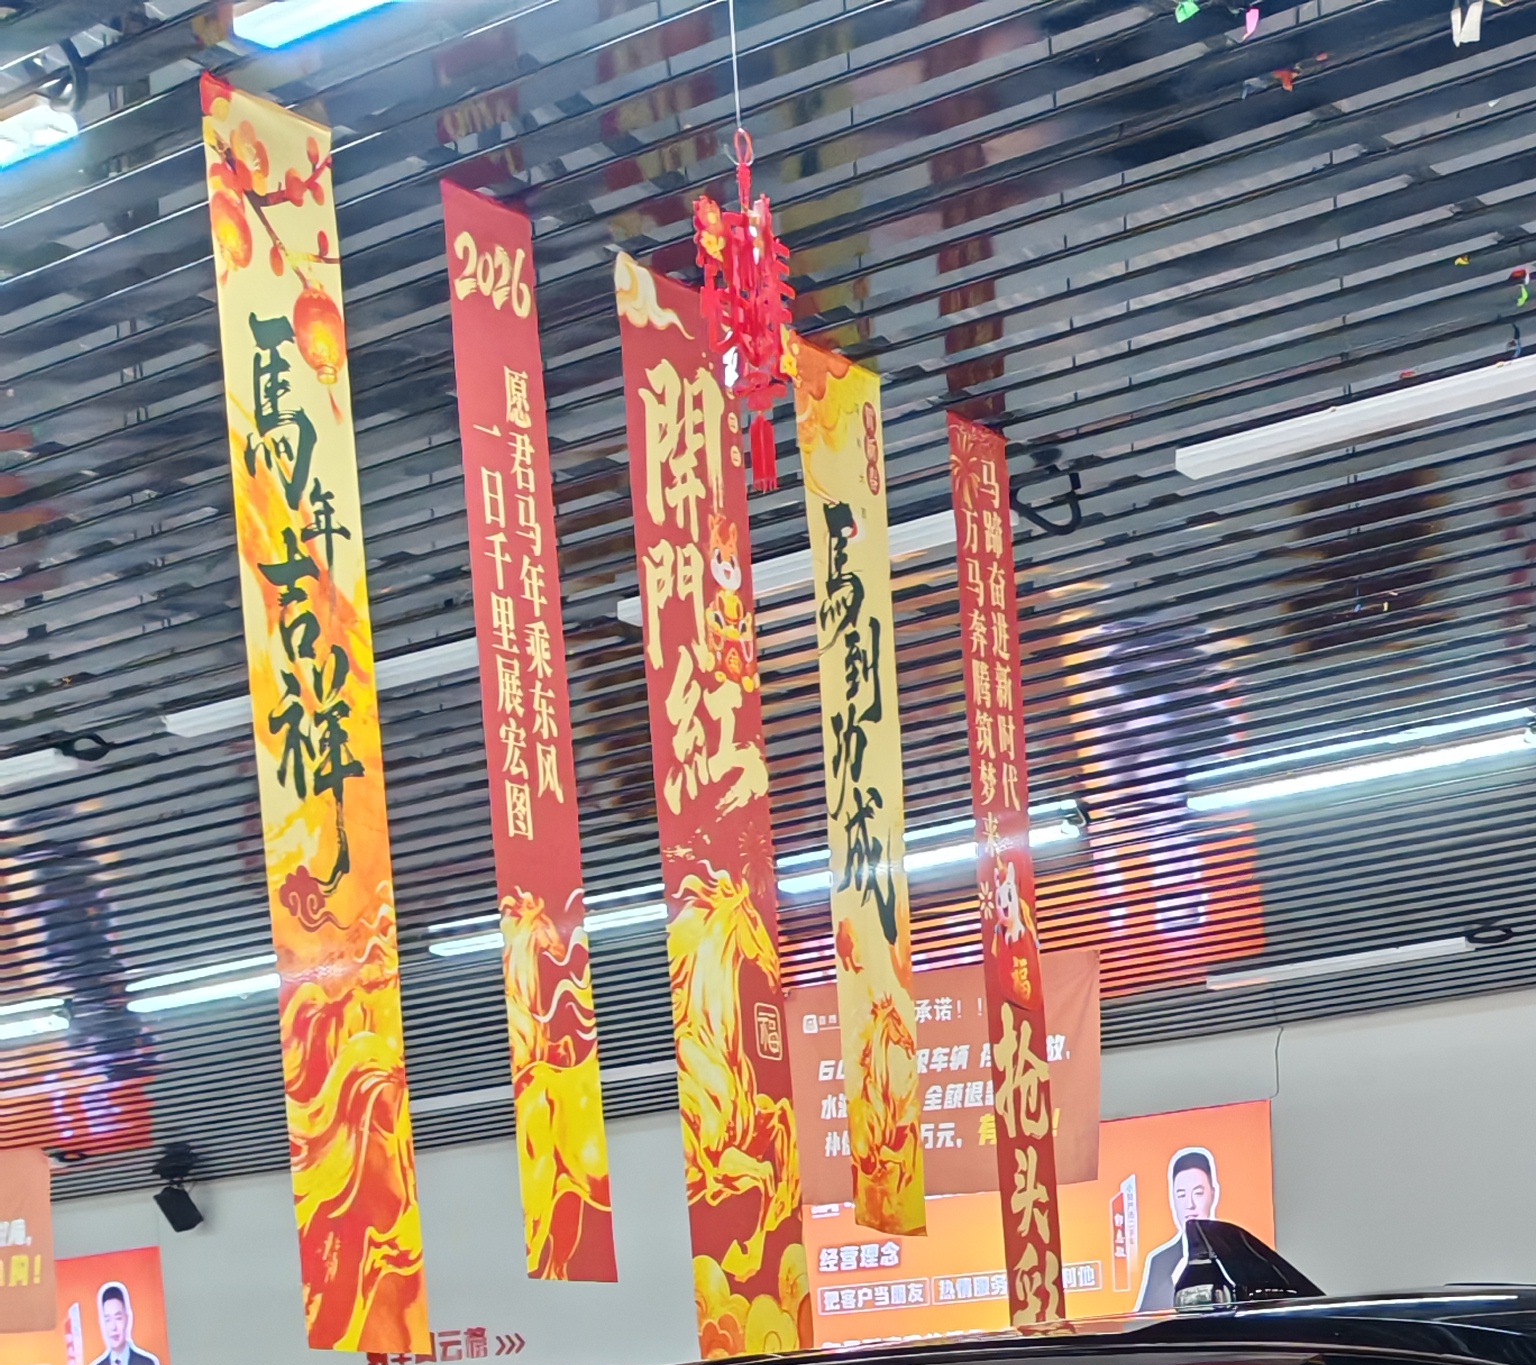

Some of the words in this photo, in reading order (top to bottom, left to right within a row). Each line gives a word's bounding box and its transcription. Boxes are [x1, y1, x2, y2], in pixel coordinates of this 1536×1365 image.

[453, 231, 532, 319] 2026
[473, 423, 534, 841] 一日千里展宏图
[503, 366, 564, 803] 愿君马年乘东风
[818, 1241, 900, 1272] 经营理念
[994, 1001, 1057, 1325] 抢头彩
